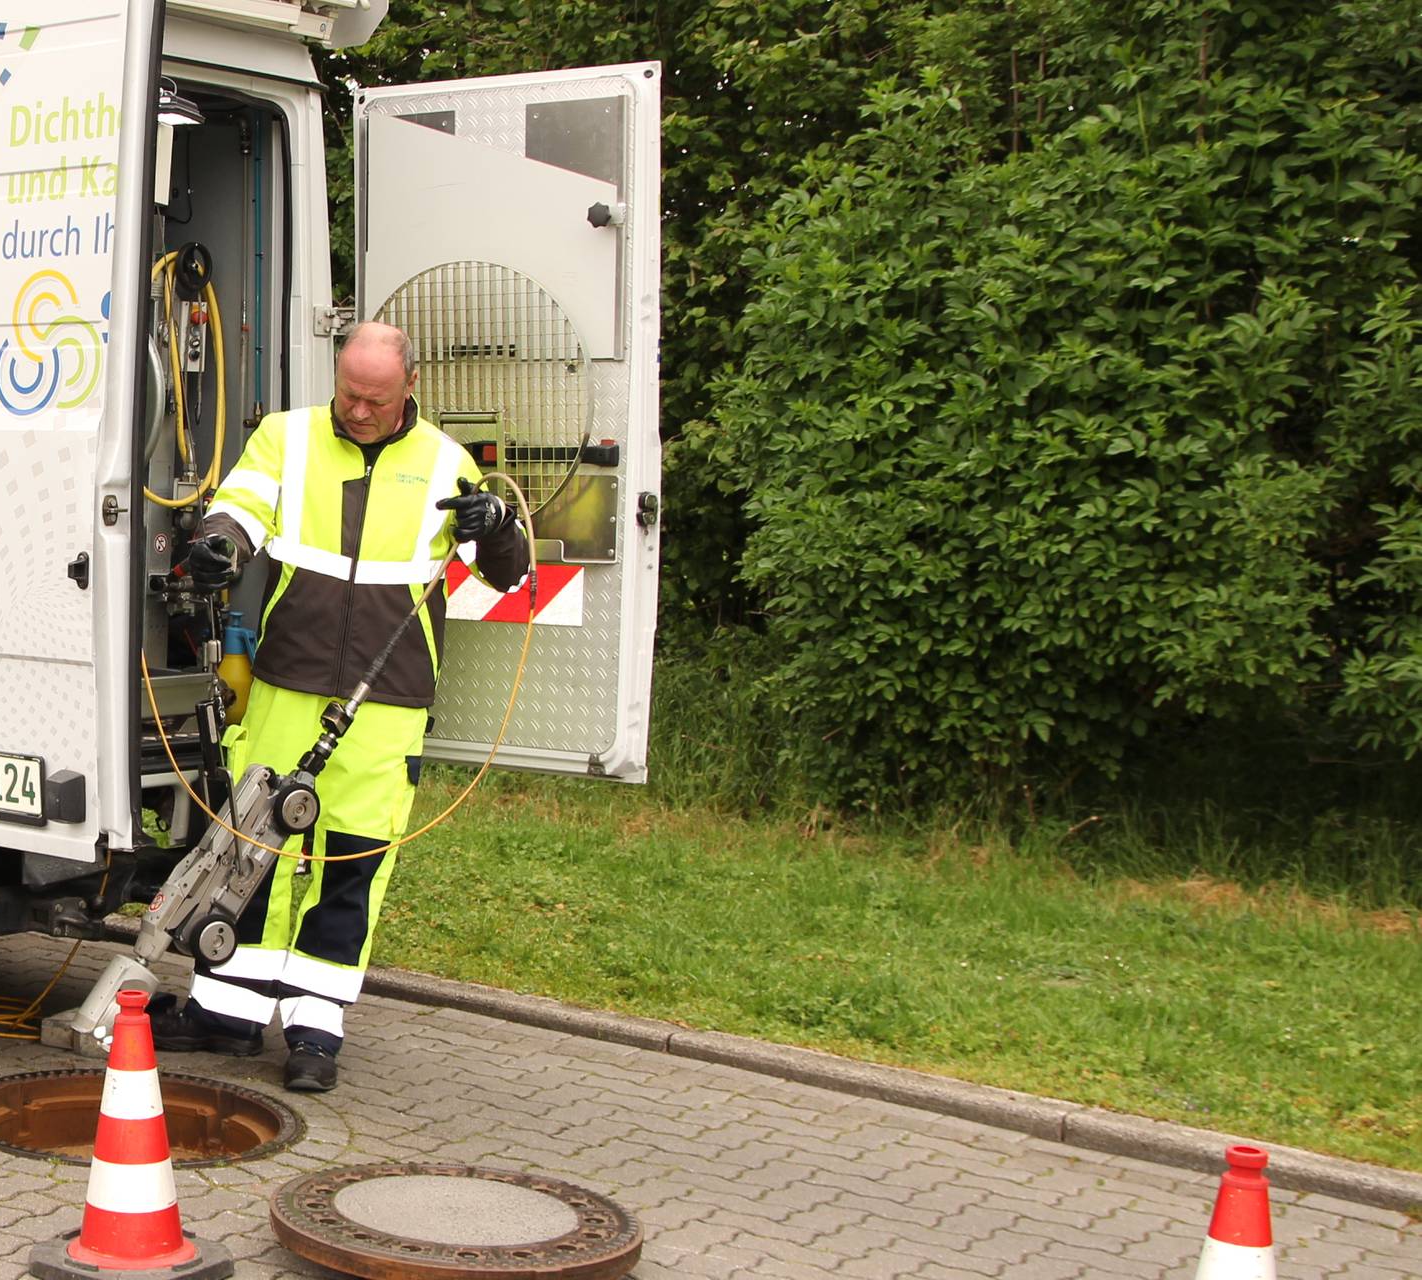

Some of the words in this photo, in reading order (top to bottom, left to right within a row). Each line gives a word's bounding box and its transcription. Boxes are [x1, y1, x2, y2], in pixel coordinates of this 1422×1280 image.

[10, 92, 121, 147] Dichth
[8, 156, 67, 204] und
[2, 214, 80, 260] durch
